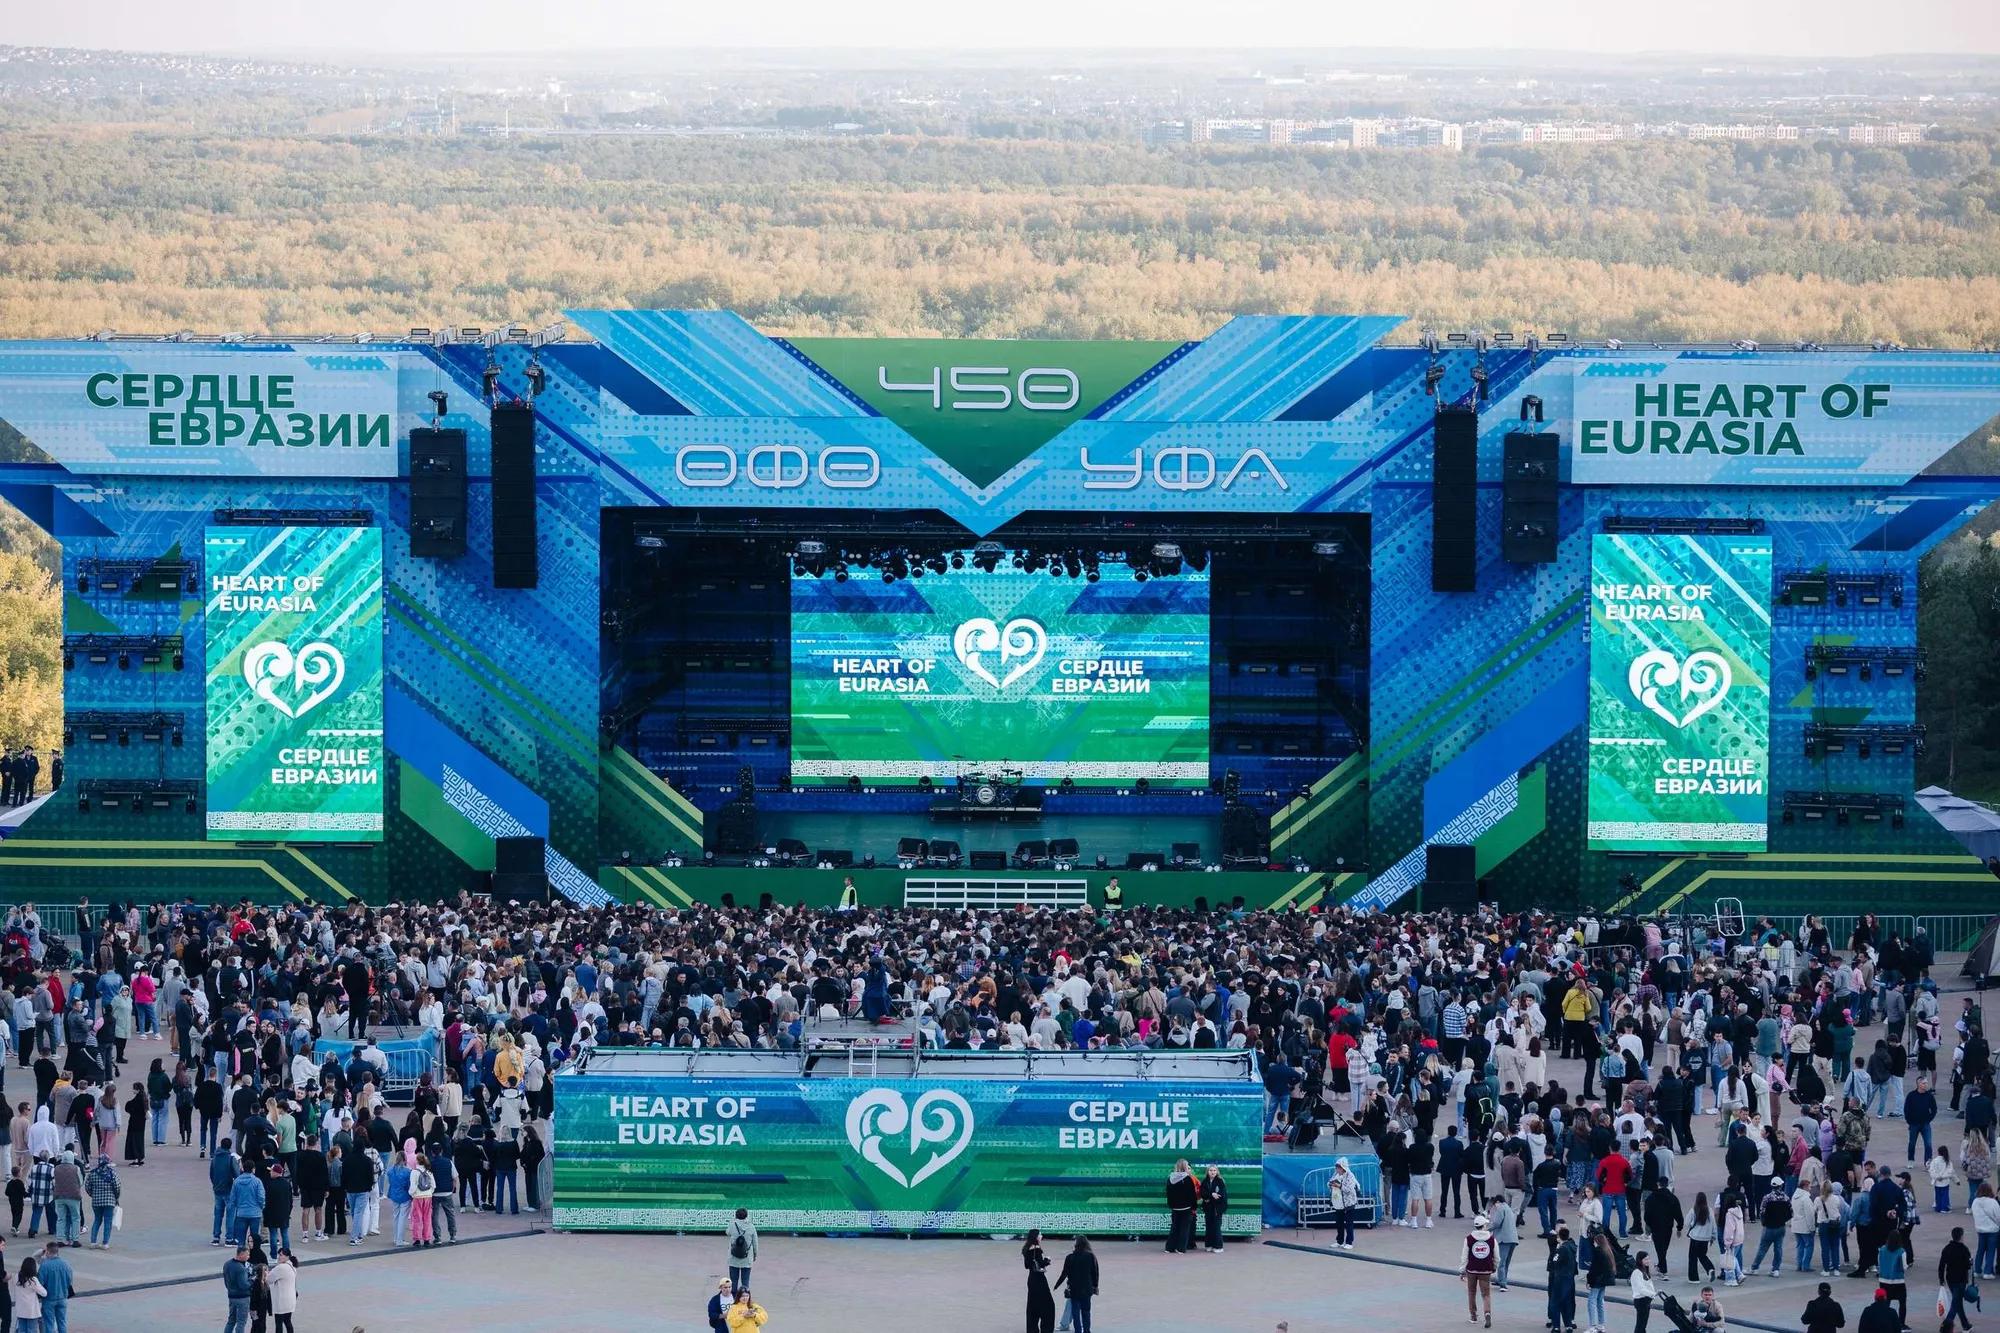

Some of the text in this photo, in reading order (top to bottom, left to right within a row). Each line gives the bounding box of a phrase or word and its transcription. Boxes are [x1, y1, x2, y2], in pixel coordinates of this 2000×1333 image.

[86, 372, 295, 415] СЕРДЦЕ
[1634, 383, 1890, 418] HEART OF
[148, 412, 391, 448] ЕВРАЗИИ
[1580, 421, 1805, 456] EURASIA
[212, 575, 325, 591] HEART OF
[1599, 584, 1713, 601] HEART OF
[219, 596, 317, 612] EURASIA
[1605, 605, 1705, 621] EURASIA
[832, 658, 937, 674] HEART OF
[1058, 659, 1144, 677] СЕРДЦЕ
[839, 677, 930, 693] EURASIA
[1052, 678, 1150, 693] ЕВРАЗИИ
[278, 748, 370, 767] СЕРДЦЕ
[271, 768, 378, 785] ЕВРАЗИИ
[1662, 758, 1755, 777] СЕРДЦЕ
[1655, 778, 1762, 795] ЕВРАЗИИ
[609, 1096, 757, 1119] HEART OF
[1068, 1101, 1190, 1126] СЕРДЦЕ
[617, 1123, 748, 1146] EURASIA
[1058, 1128, 1199, 1150] ЕВРАЗИИ
